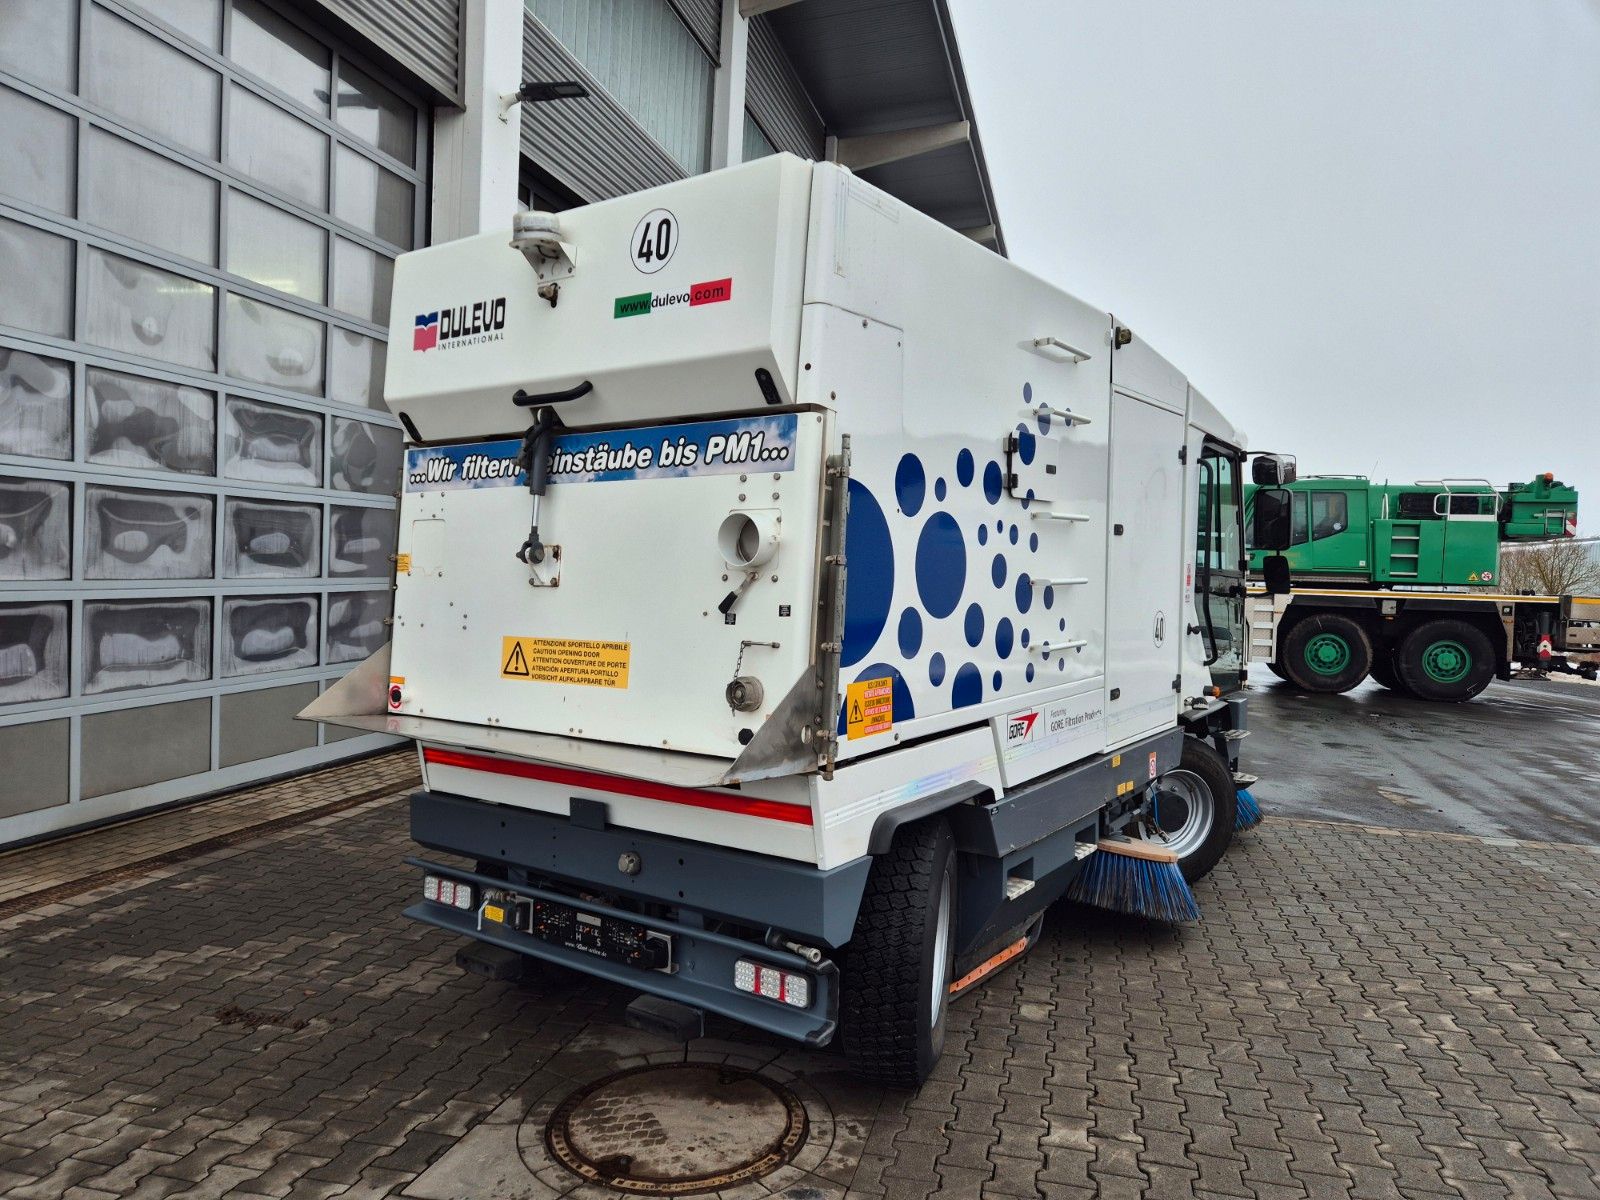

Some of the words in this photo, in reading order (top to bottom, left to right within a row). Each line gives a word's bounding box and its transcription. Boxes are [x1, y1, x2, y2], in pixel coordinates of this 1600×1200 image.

[637, 217, 671, 264] 40
[620, 286, 724, 313] www.dulevo.com
[439, 297, 506, 340] DULEVO
[438, 333, 504, 351] INTERNATIONAL
[546, 442, 653, 474] einstäube
[657, 438, 698, 468] bis
[1155, 617, 1164, 641] 40
[558, 649, 583, 657] OPENING
[568, 641, 600, 649] SPORTELLO
[601, 642, 628, 651] APRIBILE
[532, 665, 559, 673] ATENCIÓN
[560, 667, 590, 675] APERTURA
[591, 669, 619, 677] PORTILLO
[563, 659, 596, 667] OUVERTURE
[559, 676, 603, 685] AUFKLAPPBARE
[1009, 722, 1025, 739] GORE
[1050, 719, 1064, 732] GORE
